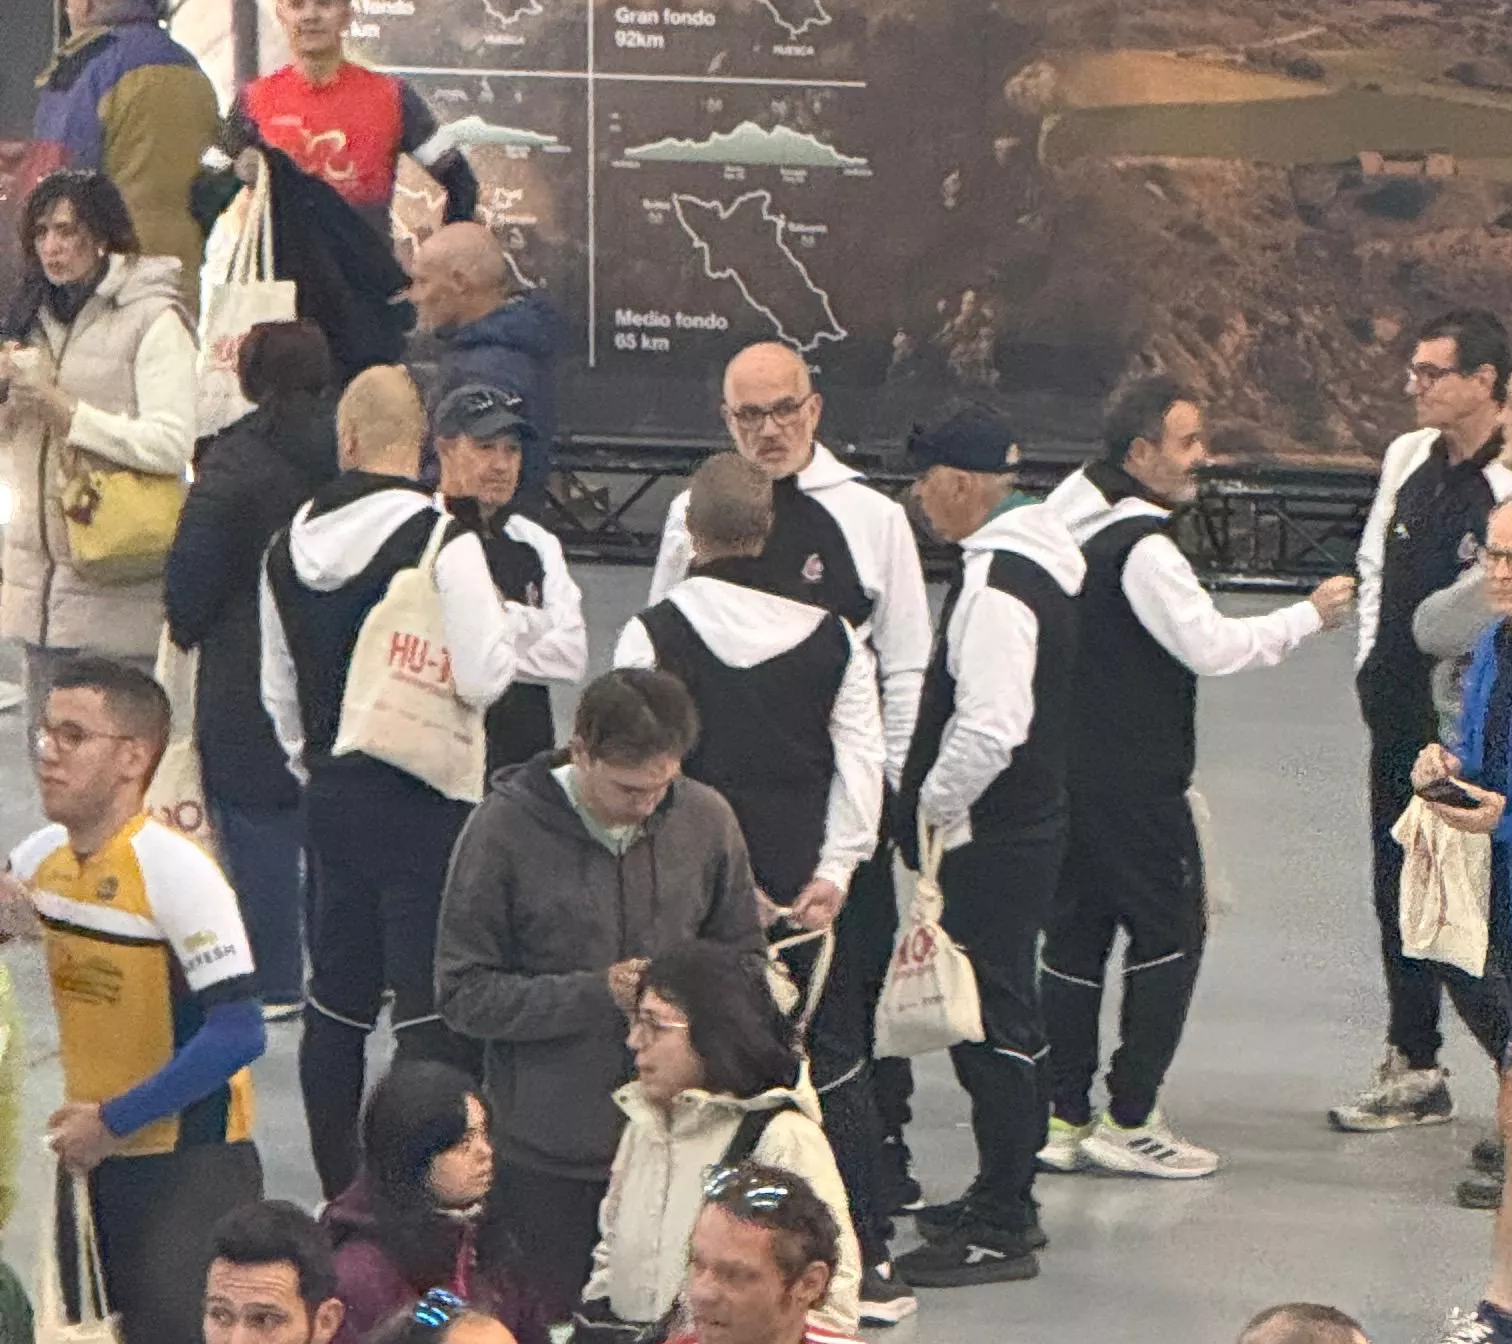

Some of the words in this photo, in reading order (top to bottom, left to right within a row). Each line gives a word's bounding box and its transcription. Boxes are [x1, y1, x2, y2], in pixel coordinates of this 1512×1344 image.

[614, 6, 659, 26] Gran
[664, 7, 716, 27] fondo
[614, 29, 665, 49] 92km
[615, 308, 671, 328] Medio
[675, 311, 728, 331] fondo
[641, 333, 670, 352] km
[387, 631, 451, 683] HU-1
